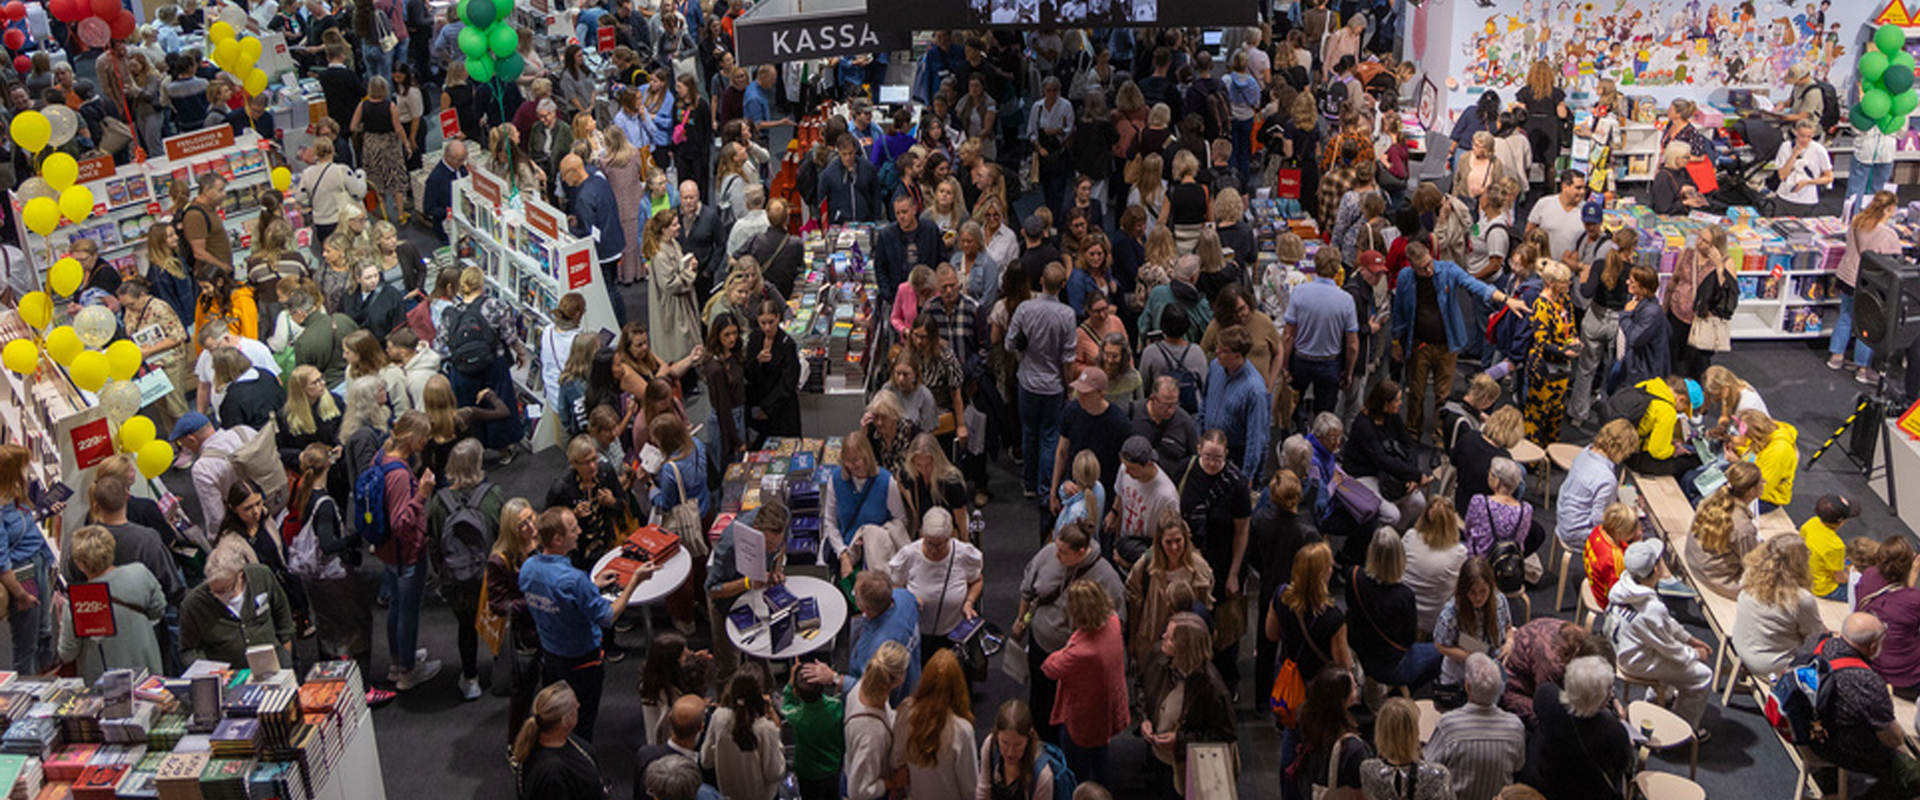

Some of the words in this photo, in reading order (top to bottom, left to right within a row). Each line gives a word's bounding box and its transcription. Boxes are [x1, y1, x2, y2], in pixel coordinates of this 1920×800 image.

[772, 22, 880, 56] KASSA
[176, 133, 216, 148] FEELGOOD
[182, 139, 221, 154] ROMANCE
